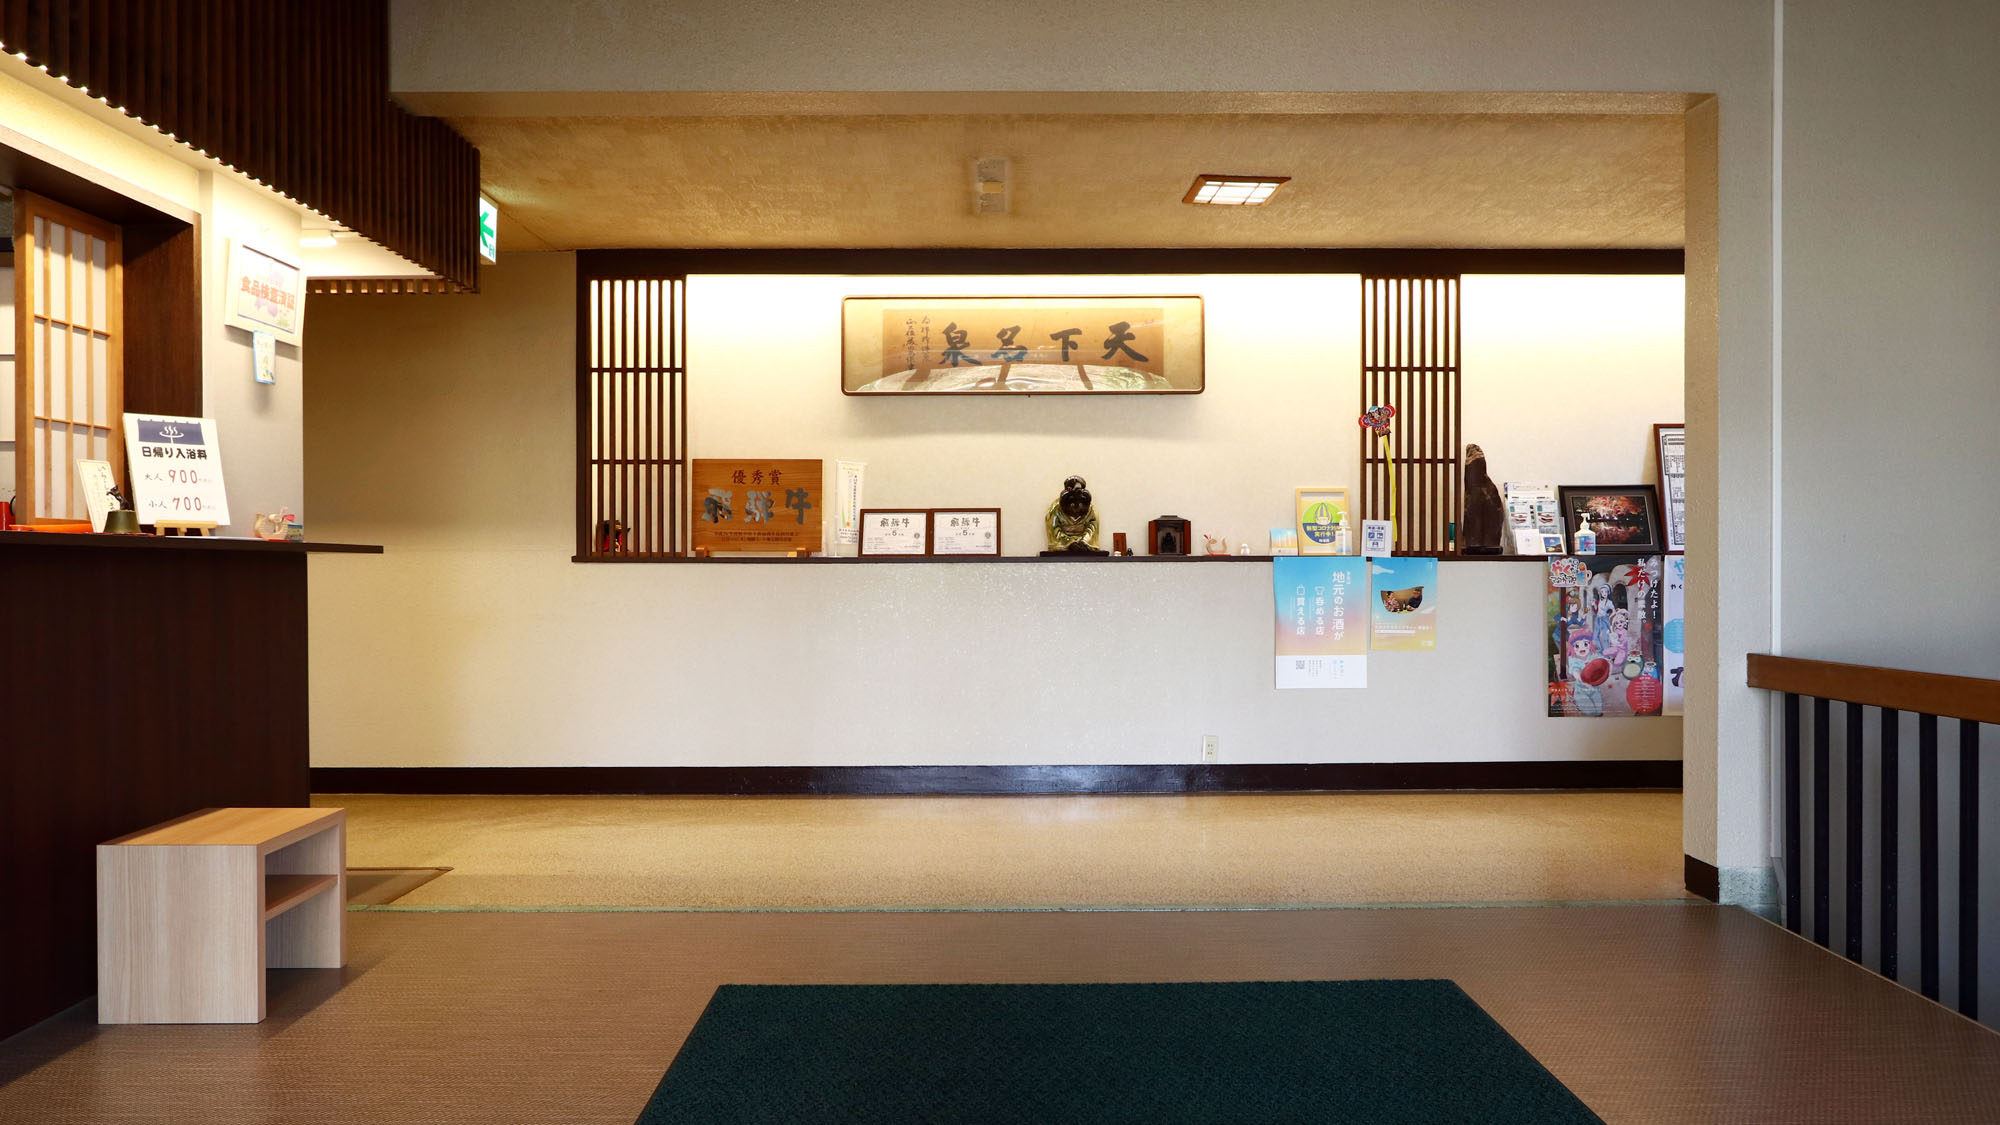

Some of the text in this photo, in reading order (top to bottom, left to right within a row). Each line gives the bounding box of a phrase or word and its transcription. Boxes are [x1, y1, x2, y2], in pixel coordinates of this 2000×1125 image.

[142, 446, 207, 460] 日帰り入浴料
[145, 472, 163, 481] 大人
[168, 469, 198, 484] 900
[732, 469, 783, 485] 優秀賞
[148, 501, 167, 510] 小人
[173, 497, 202, 511] 700
[702, 487, 813, 525] 飛騨牛
[1332, 571, 1345, 640] 地元のお酒が
[1296, 598, 1305, 635] 買える店
